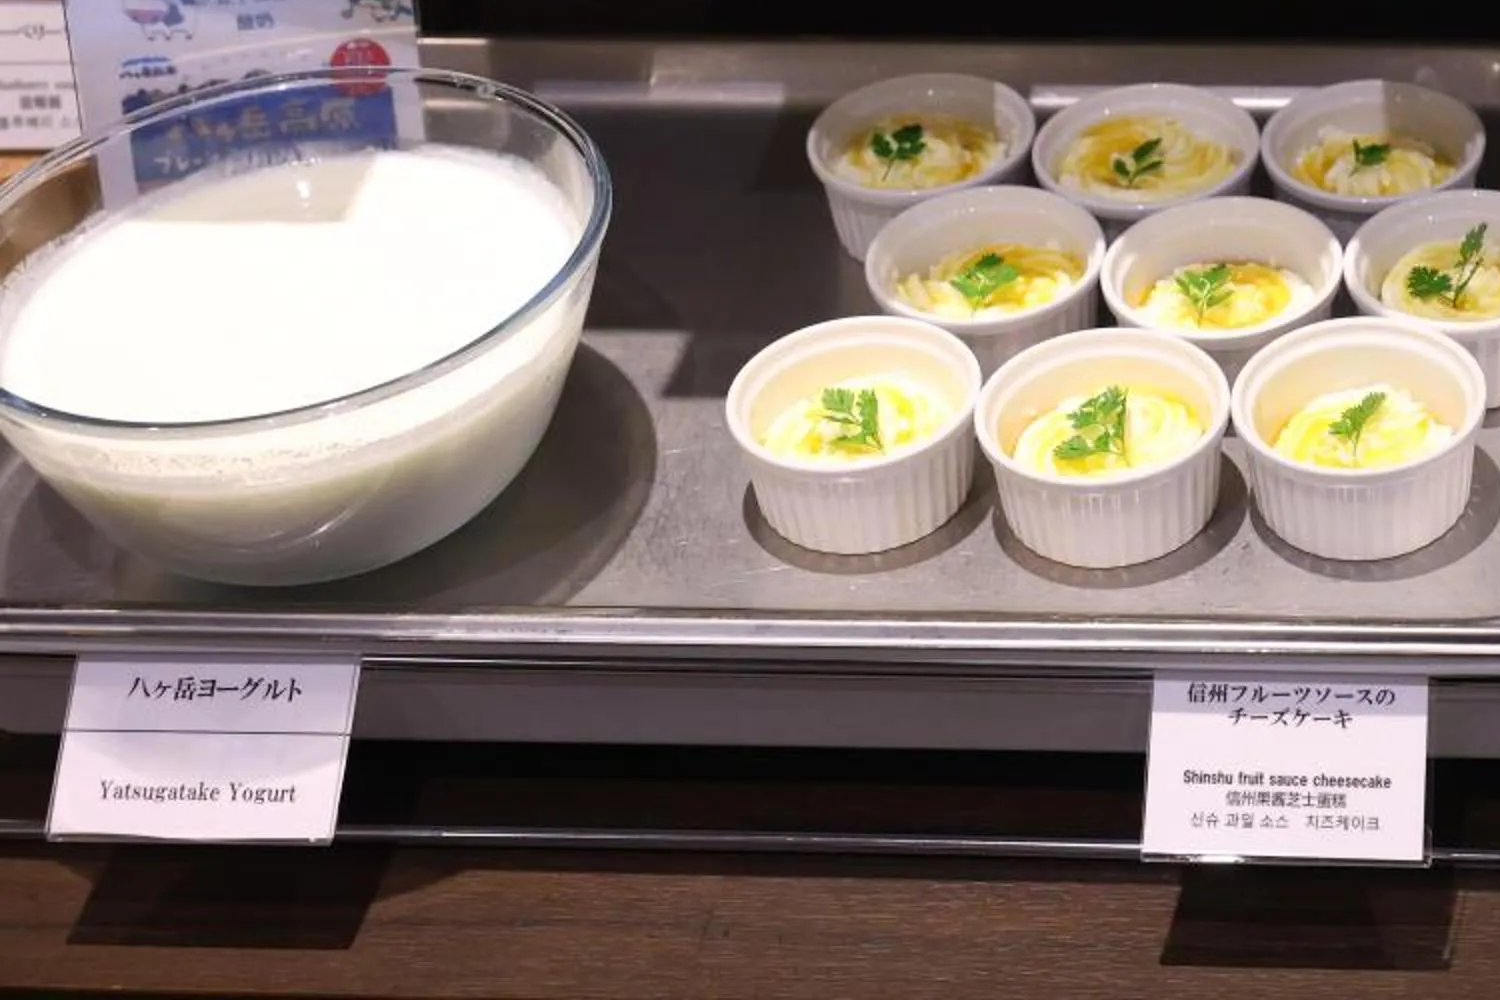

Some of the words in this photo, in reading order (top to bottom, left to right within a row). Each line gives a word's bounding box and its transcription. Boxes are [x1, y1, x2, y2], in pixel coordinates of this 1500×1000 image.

[127, 676, 303, 702] 八ヶ岳ヨーグルト
[1188, 683, 1396, 706] 信州フルーツソースの
[1229, 708, 1353, 729] チーズケーキ
[1183, 769, 1233, 786] Shinshu
[1238, 769, 1264, 786] fruit
[1269, 773, 1308, 787] sauce
[1313, 772, 1392, 789] cheesecake
[99, 780, 221, 803] Yatsugatake
[229, 781, 296, 804] Yogurt
[1190, 812, 1220, 829] 신슈
[1224, 812, 1255, 830] 과일
[1259, 814, 1290, 830] 소스
[1305, 814, 1380, 832] 치즈케이크
